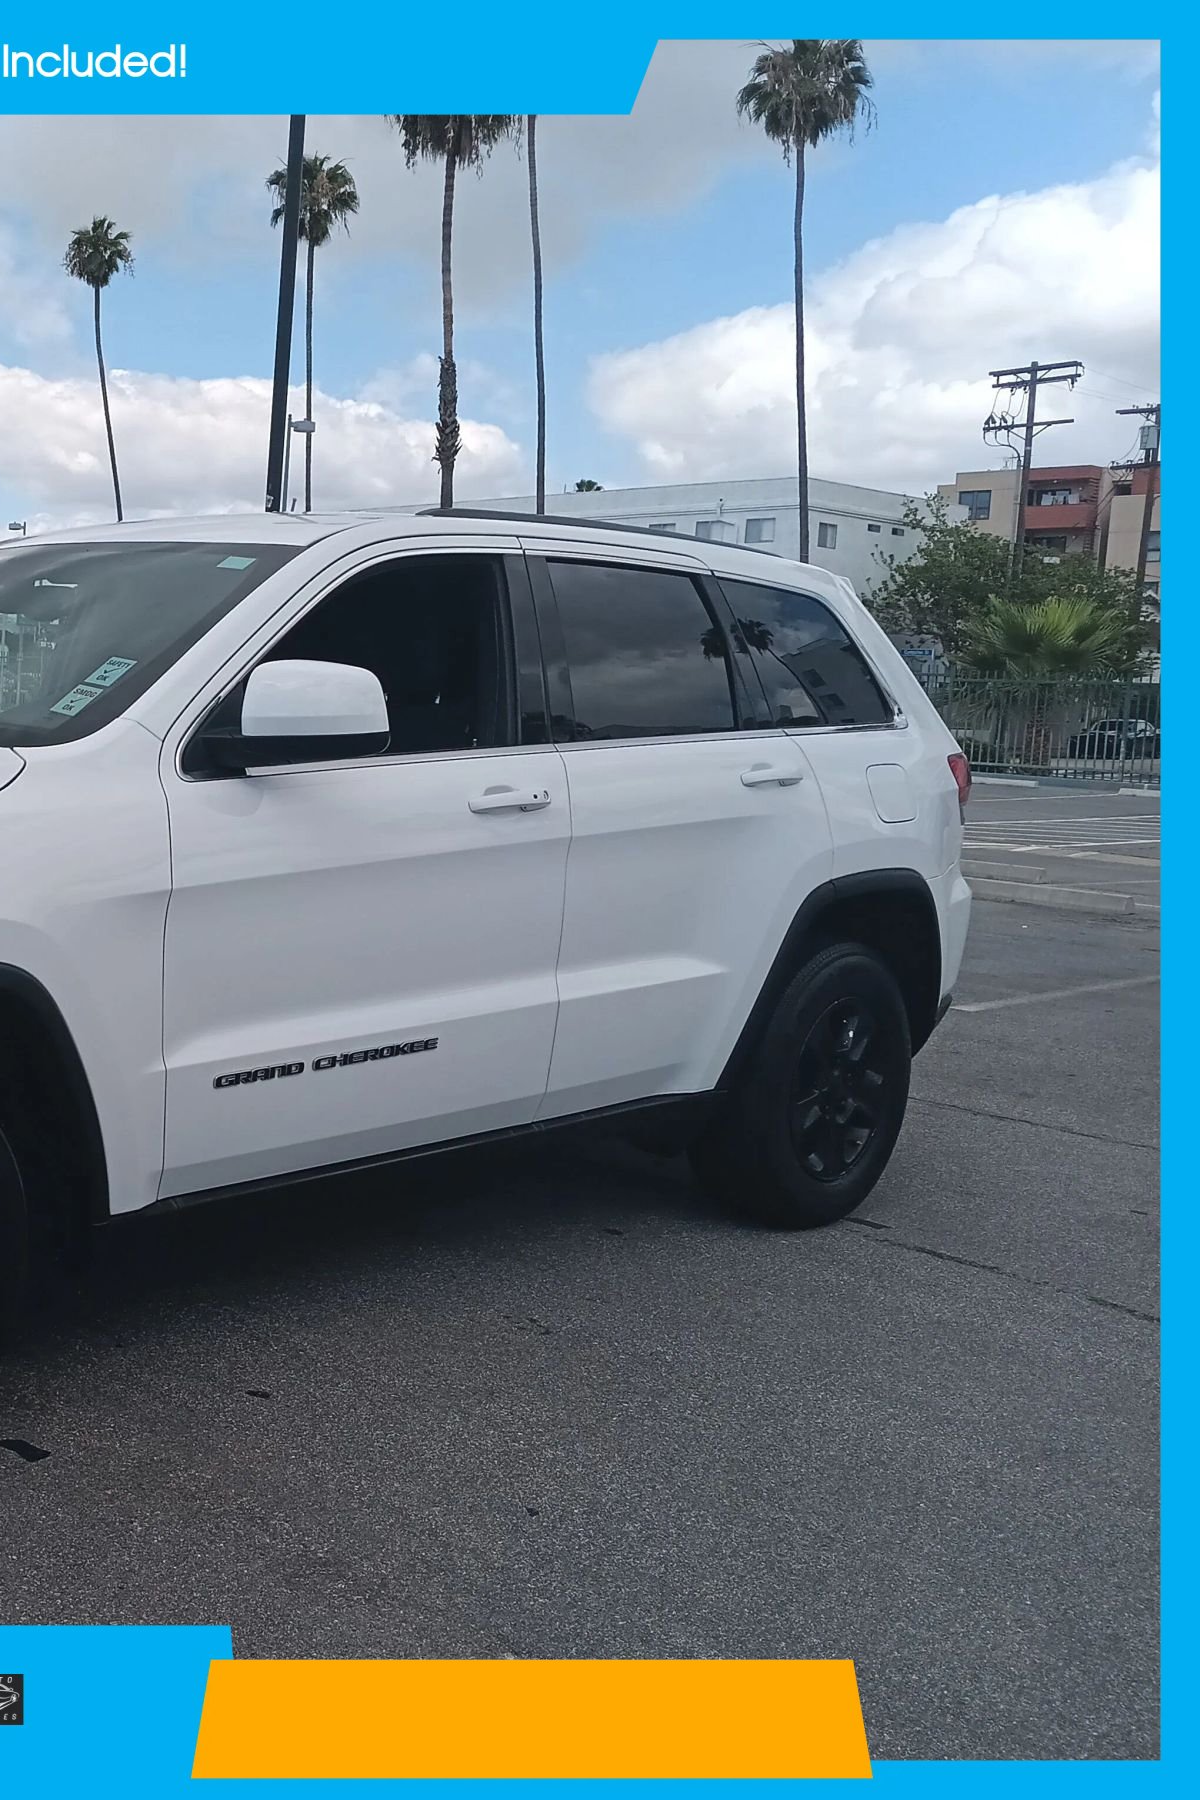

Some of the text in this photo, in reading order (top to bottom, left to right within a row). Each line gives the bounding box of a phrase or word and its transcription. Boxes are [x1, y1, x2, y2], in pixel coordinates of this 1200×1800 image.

[106, 659, 132, 669] SAFETY
[96, 674, 110, 682] OK
[73, 688, 98, 698] SMOG
[62, 703, 75, 711] OK
[212, 1036, 439, 1089] GRAND CHEROKEE
